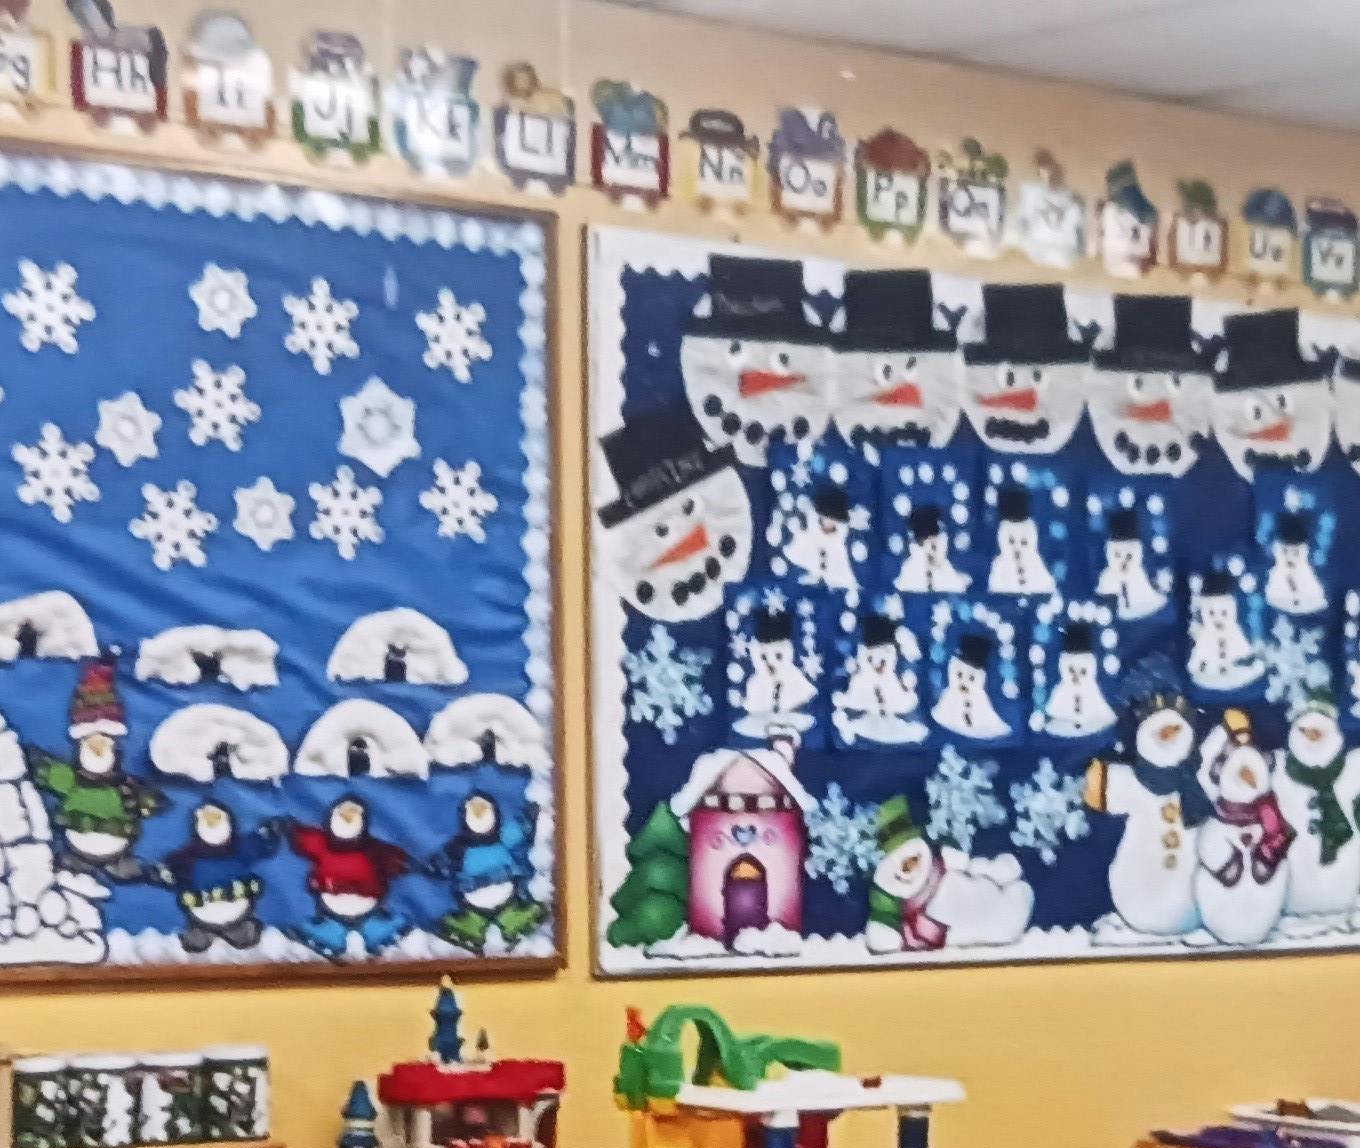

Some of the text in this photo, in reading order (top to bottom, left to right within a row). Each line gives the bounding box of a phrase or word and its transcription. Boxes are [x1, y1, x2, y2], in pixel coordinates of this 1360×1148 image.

[91, 51, 148, 95] Hh
[700, 143, 744, 185] Nn
[784, 156, 828, 195] Oo
[874, 172, 909, 223] Pp
